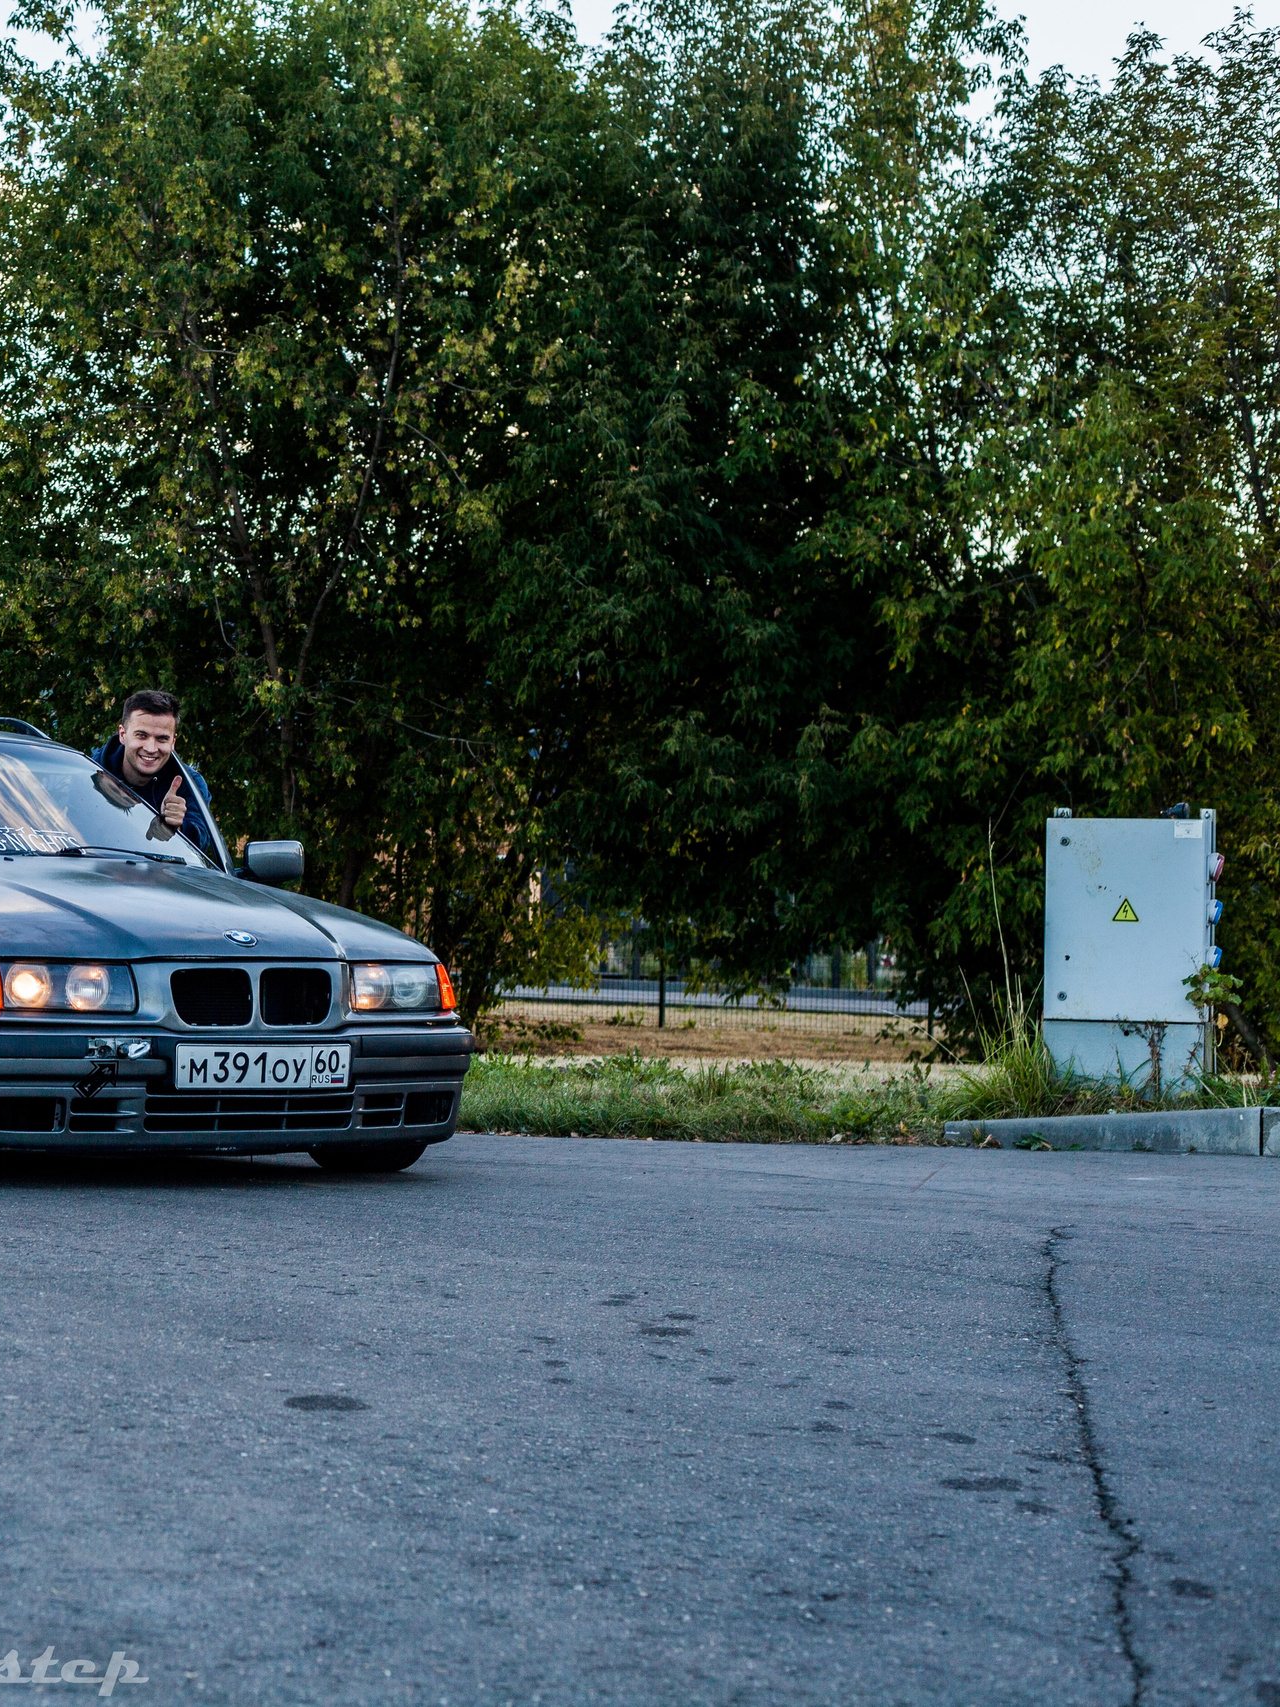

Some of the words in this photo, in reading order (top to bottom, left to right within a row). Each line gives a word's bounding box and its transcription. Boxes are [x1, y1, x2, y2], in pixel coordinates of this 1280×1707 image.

[3, 832, 87, 855] NIGHTS
[188, 1051, 307, 1084] М391ОУ
[314, 1049, 340, 1074] 60
[311, 1074, 331, 1084] RUS
